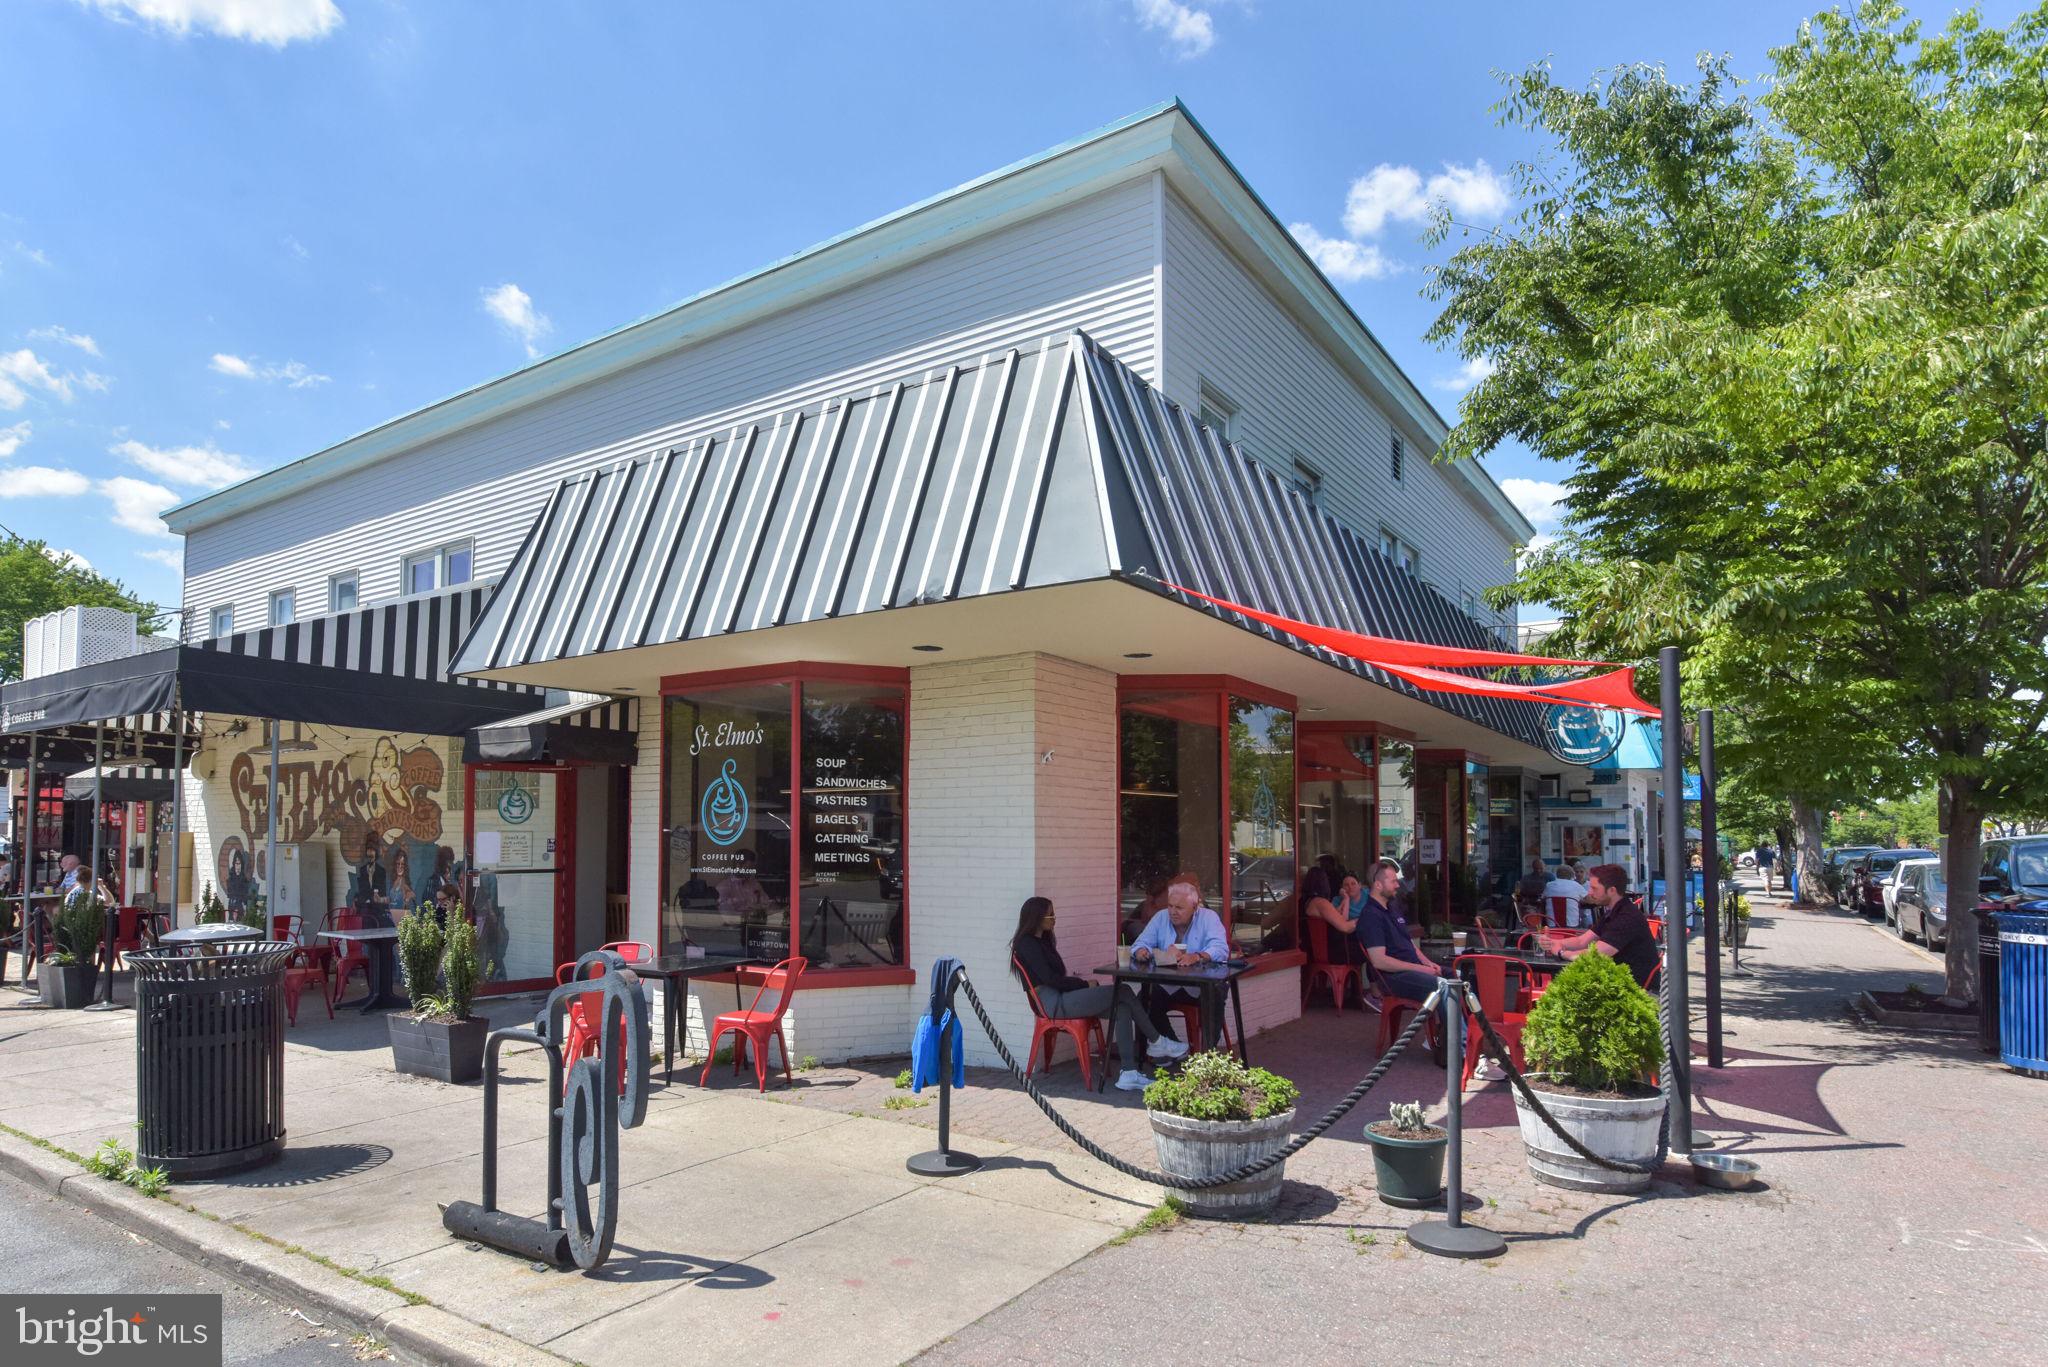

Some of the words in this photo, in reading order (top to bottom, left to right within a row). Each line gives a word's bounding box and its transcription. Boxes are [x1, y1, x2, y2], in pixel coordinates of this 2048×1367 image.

[689, 724, 711, 756] St.
[714, 721, 764, 747] Elmo's
[816, 757, 847, 768] SOUP
[402, 767, 441, 789] COFFEE
[815, 777, 887, 789] SANDWICHES
[815, 795, 868, 806] PASTRIES
[815, 814, 859, 825] BAGELS
[373, 810, 439, 841] PROVISIONS
[815, 833, 869, 844] CATERING
[701, 853, 728, 861] COFFEE
[814, 852, 870, 863] MEETINGS
[690, 866, 757, 874] www.StElmosCoffeePub.com
[748, 940, 790, 950] STUMPTOWN
